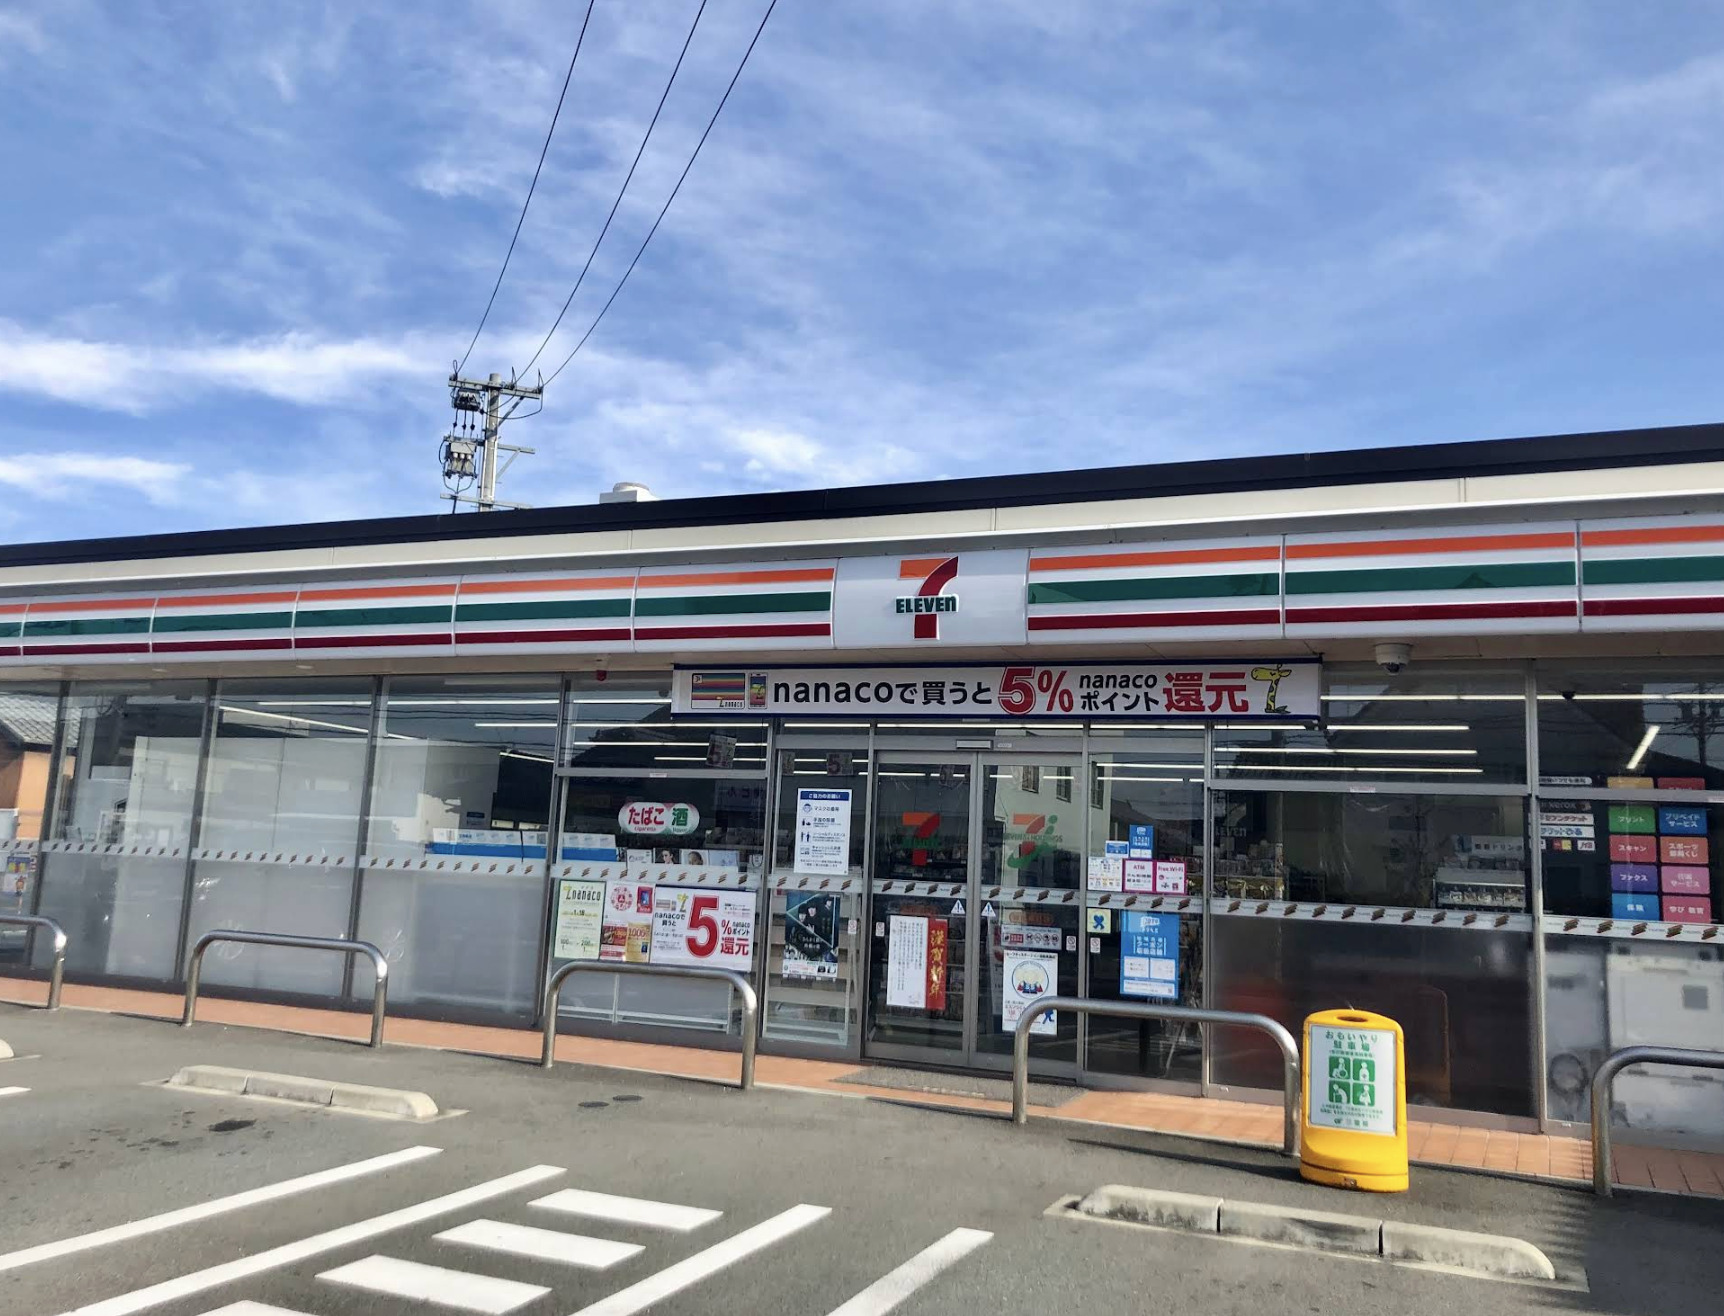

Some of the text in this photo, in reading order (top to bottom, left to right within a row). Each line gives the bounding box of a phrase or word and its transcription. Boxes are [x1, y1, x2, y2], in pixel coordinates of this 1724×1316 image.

[773, 665, 1073, 716] nanacoで買うと 5%
[1079, 673, 1158, 689] nanaco
[1080, 691, 1159, 712] ポイント
[1163, 671, 1249, 713] 還元
[628, 806, 665, 826] たばこ
[671, 807, 689, 827] 酒
[572, 889, 602, 901] nanaco
[654, 912, 686, 921] nanacoで
[686, 894, 720, 959] 5
[720, 937, 750, 956] 還元
